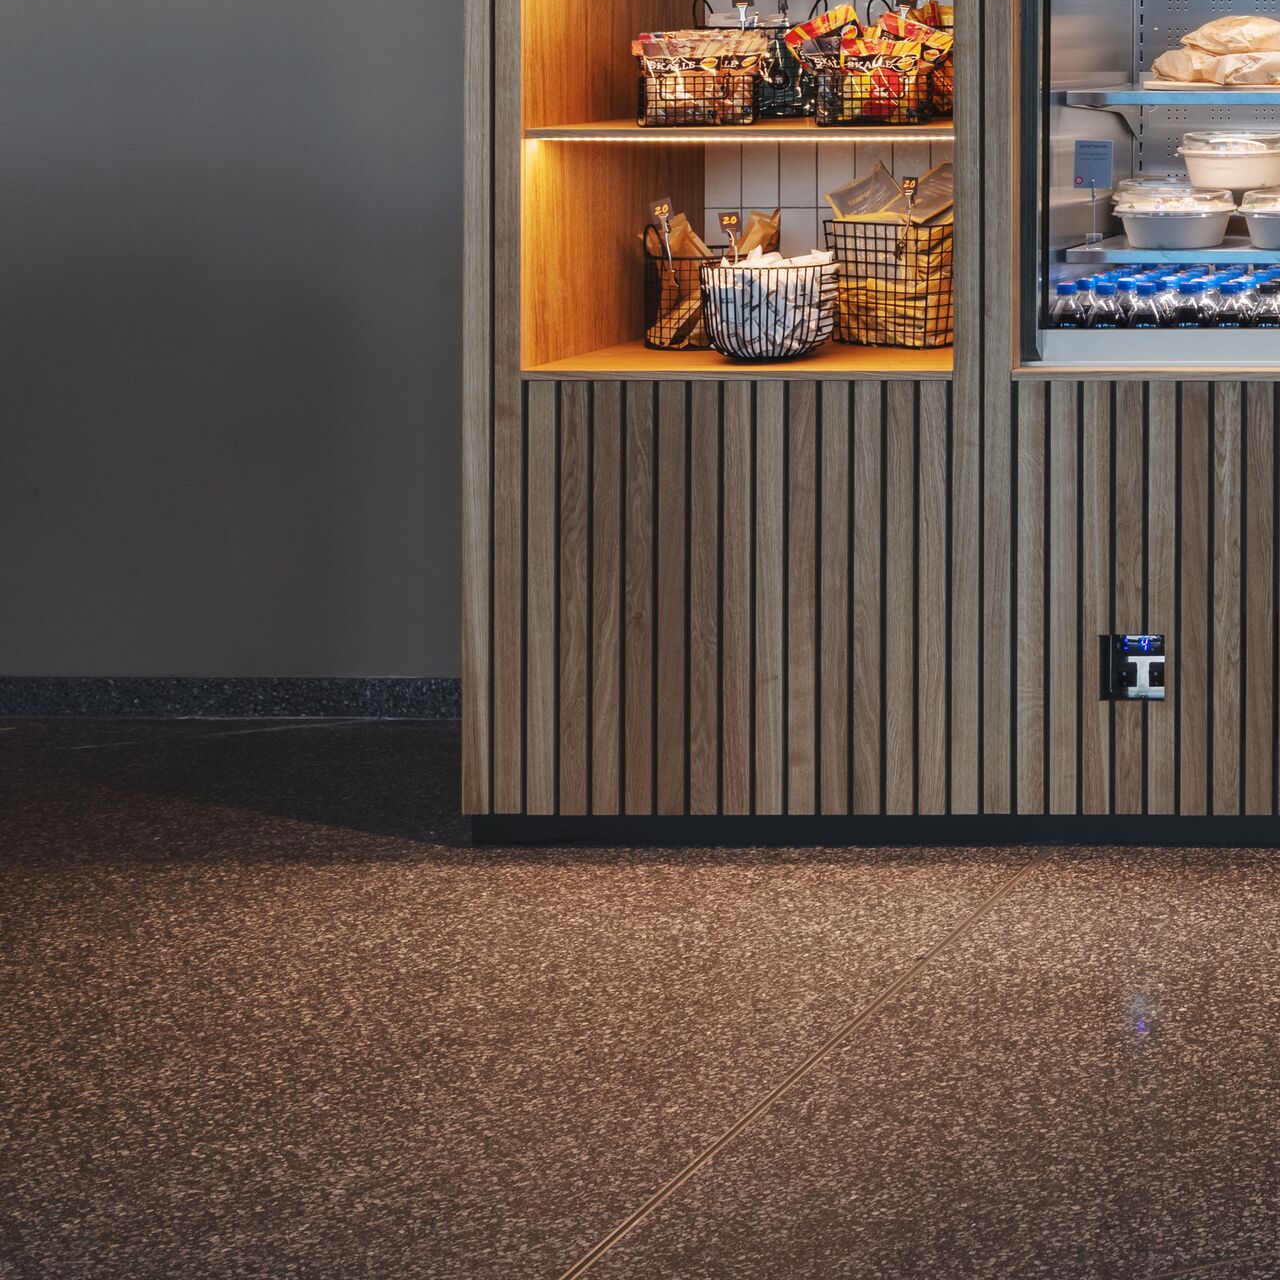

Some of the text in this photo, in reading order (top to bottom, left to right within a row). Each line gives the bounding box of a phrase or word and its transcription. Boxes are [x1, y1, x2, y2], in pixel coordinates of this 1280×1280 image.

[903, 179, 916, 188] 20
[654, 204, 669, 216] 20
[722, 215, 738, 225] 20
